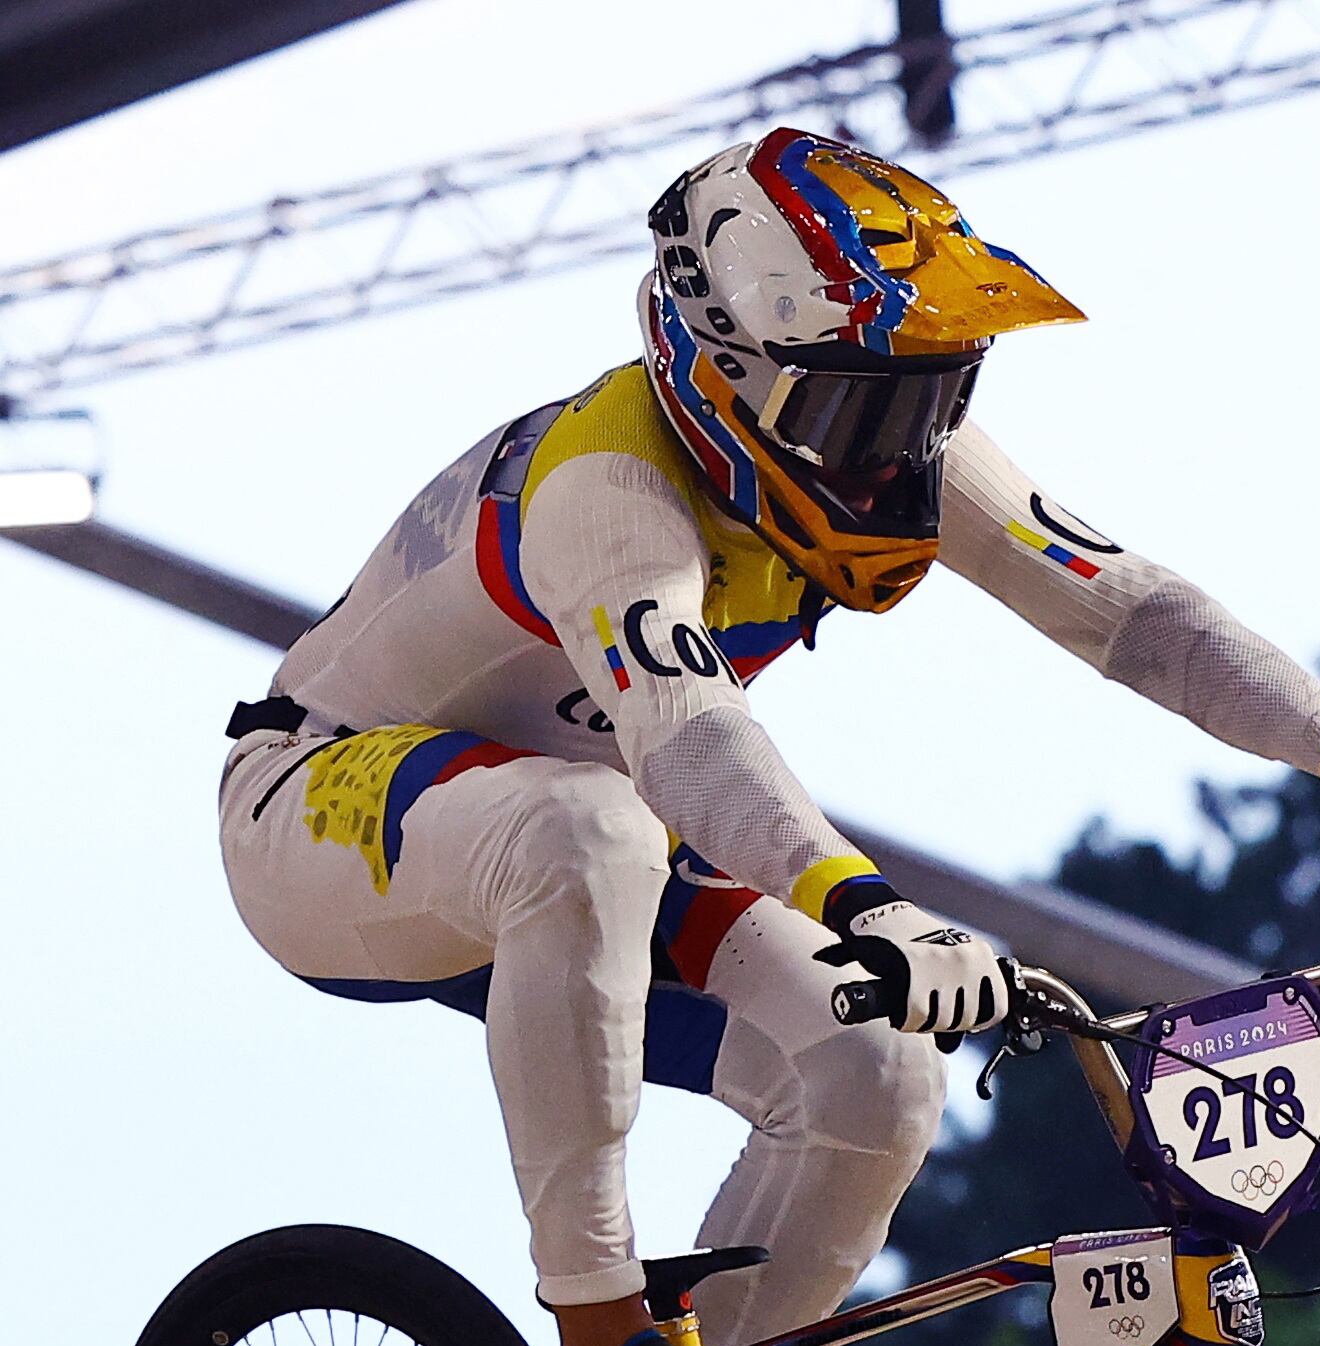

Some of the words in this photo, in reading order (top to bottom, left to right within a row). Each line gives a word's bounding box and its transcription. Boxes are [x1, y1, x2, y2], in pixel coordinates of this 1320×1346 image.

[1181, 1033, 1235, 1058] PARIS
[1240, 1020, 1288, 1047] 2024
[1183, 1065, 1305, 1163] 278
[1083, 1261, 1151, 1309] 278
